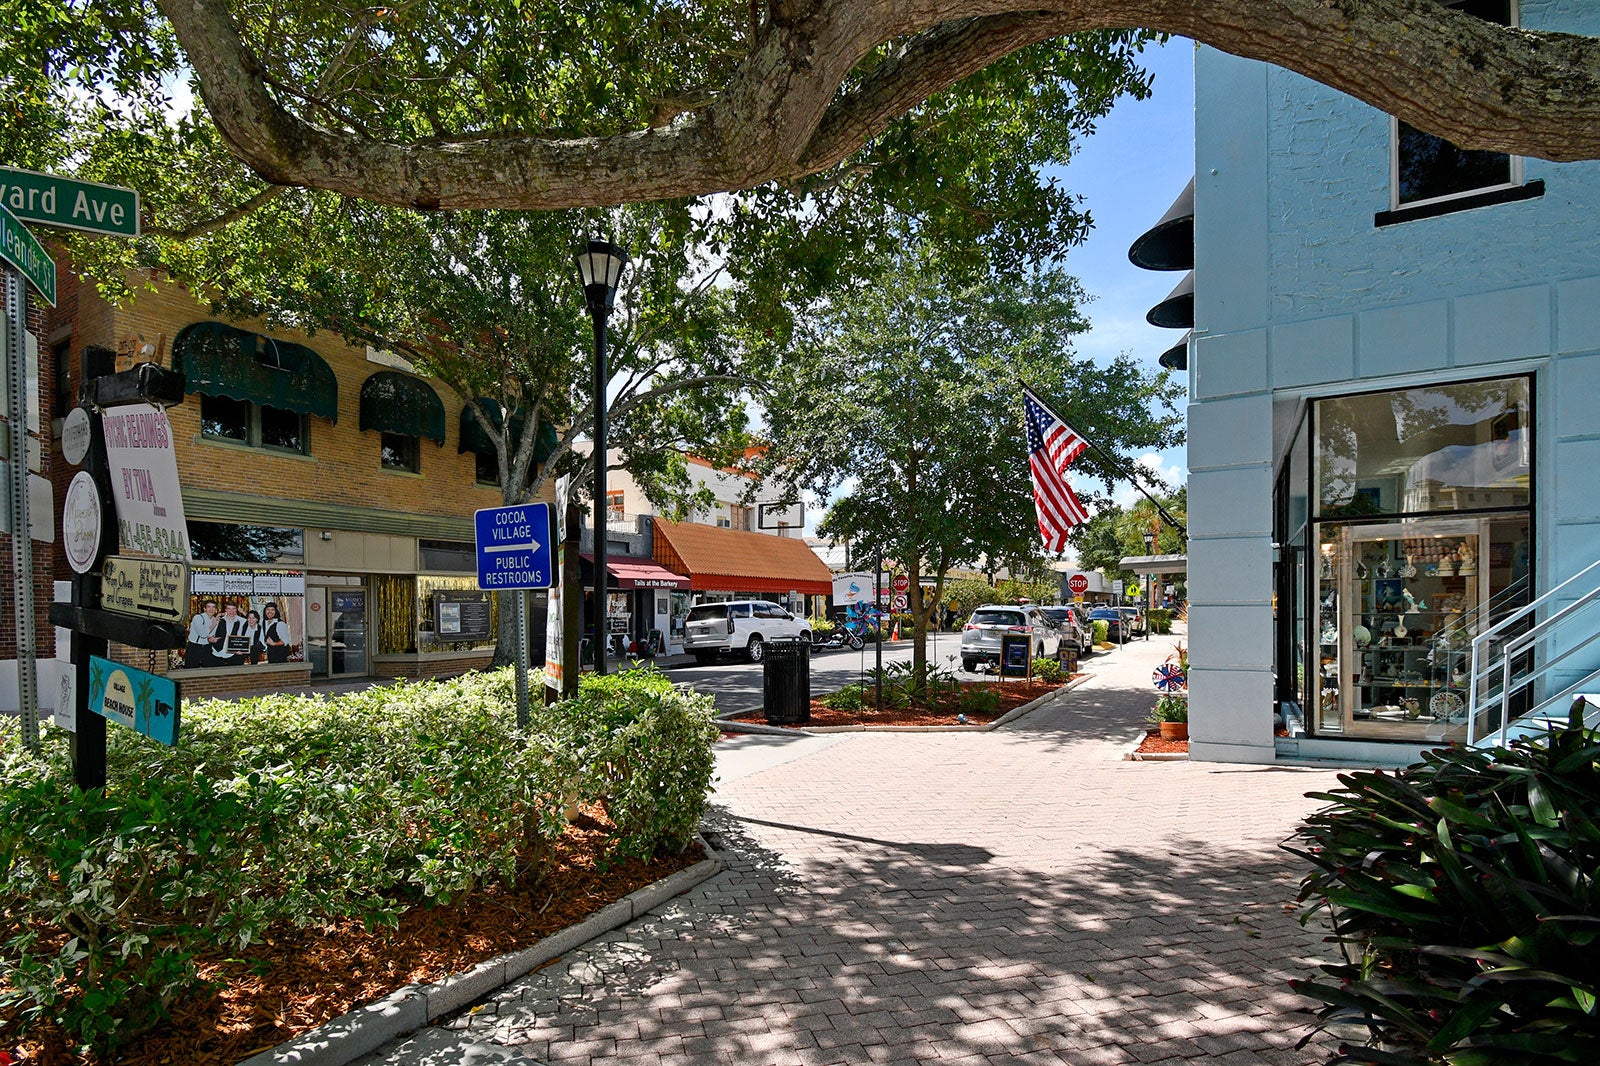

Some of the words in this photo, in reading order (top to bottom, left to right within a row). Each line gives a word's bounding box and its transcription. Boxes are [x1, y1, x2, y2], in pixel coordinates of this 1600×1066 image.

[72, 190, 125, 226] Ave
[126, 412, 169, 449] READINGS
[122, 468, 134, 500] BY
[133, 468, 157, 504] TINA
[495, 510, 526, 525] COCOA
[492, 525, 531, 541] VILLAGE
[496, 556, 530, 570] PUBLIC
[118, 570, 134, 589] Olives
[486, 570, 542, 586] RESTROOMS
[660, 580, 678, 588] Barkery
[1069, 579, 1088, 588] STOP
[104, 697, 119, 713] BEACH
[119, 702, 134, 718] HOUSE
